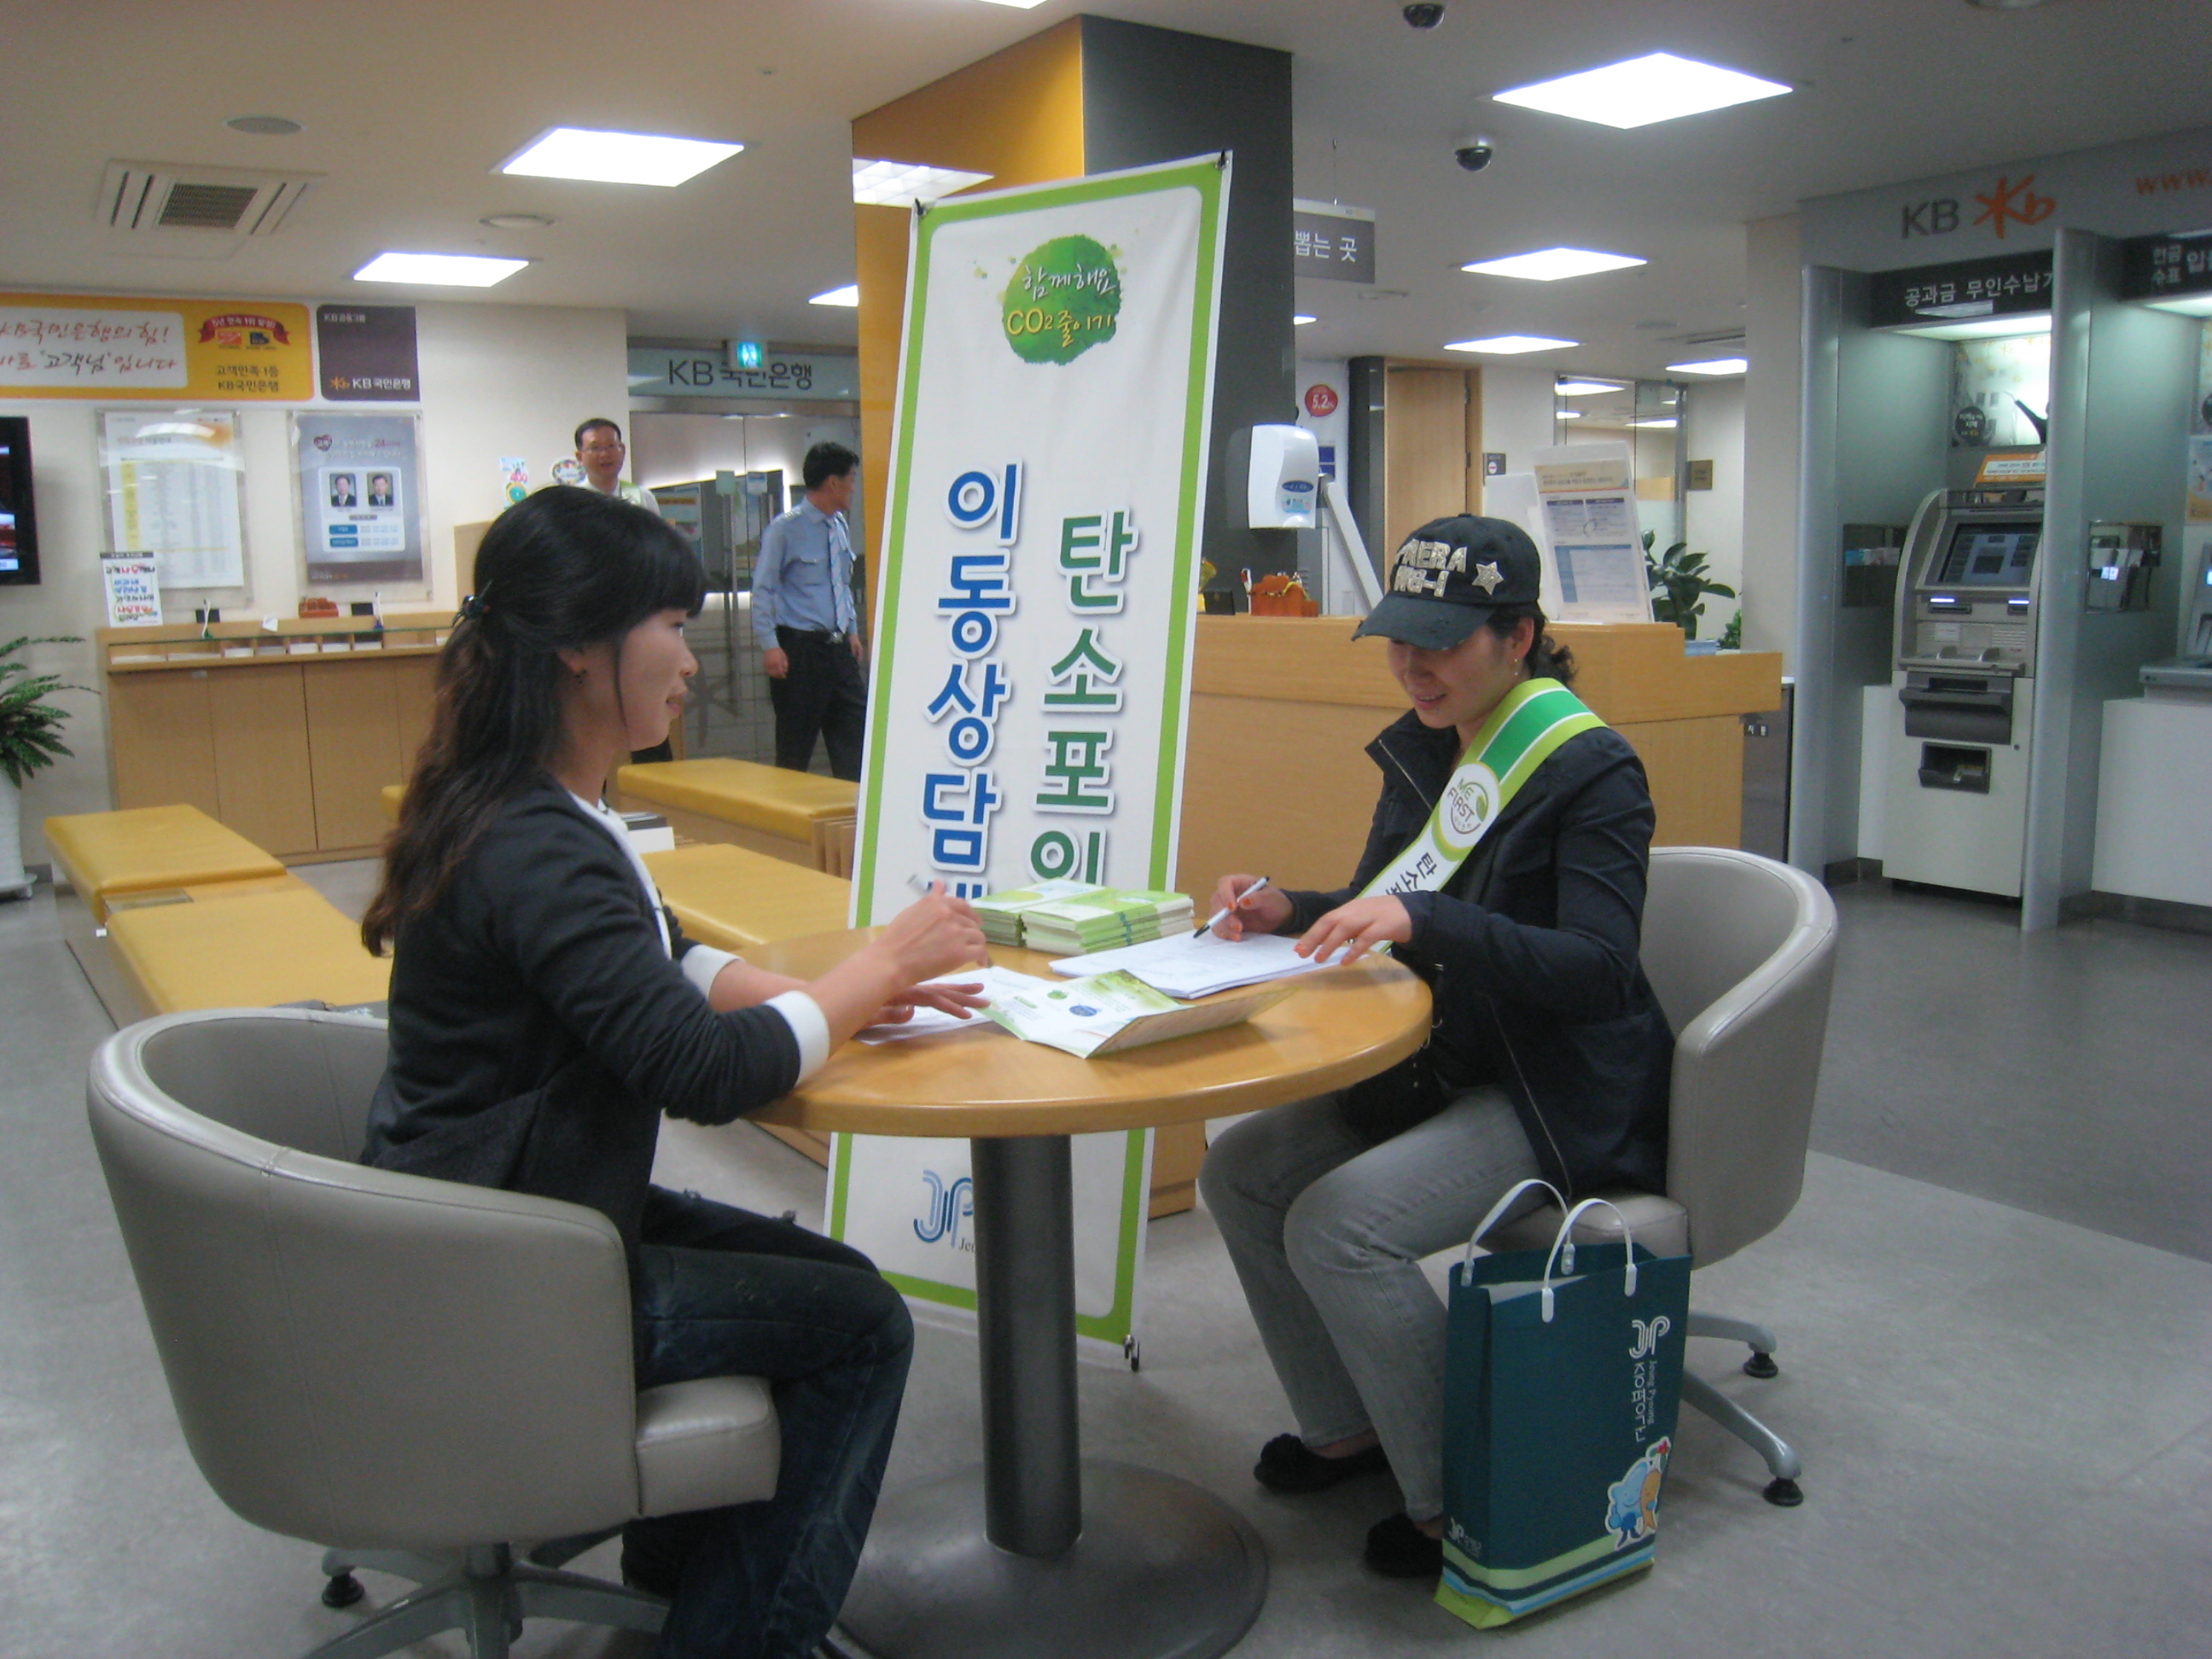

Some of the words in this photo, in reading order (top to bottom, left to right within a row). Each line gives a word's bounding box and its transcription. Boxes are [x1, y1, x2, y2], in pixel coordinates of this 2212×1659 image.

[1294, 230, 1330, 259] 뽑는
[1339, 237, 1357, 263] 곳
[1904, 282, 1957, 307] 공과금
[923, 464, 1018, 899] 이동상담
[1447, 787, 1476, 822] FIRST
